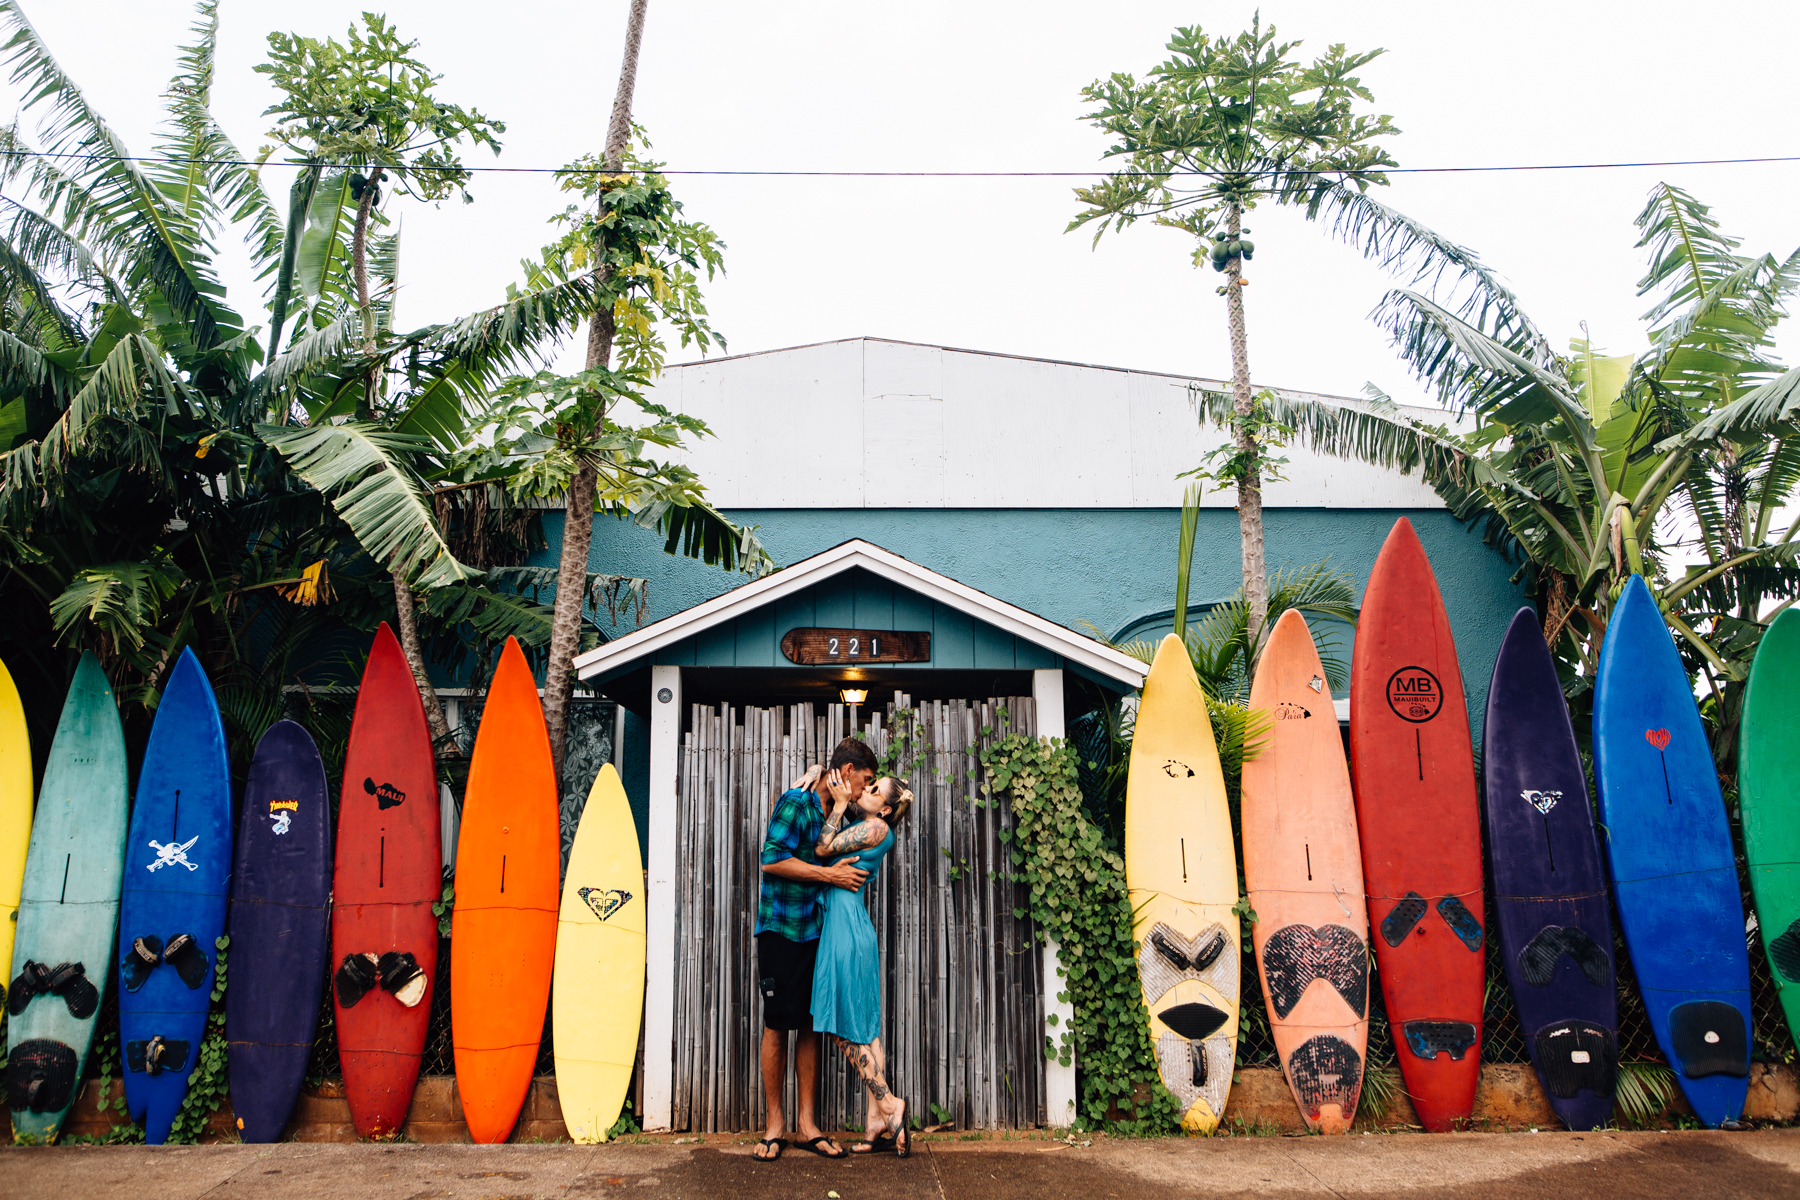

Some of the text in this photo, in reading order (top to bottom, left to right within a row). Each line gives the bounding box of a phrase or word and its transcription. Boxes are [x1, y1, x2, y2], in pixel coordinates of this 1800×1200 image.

[829, 638, 877, 655] 221
[1396, 677, 1432, 692] MB
[376, 787, 404, 802] MAUI
[1200, 939, 1218, 960] DAKINE
